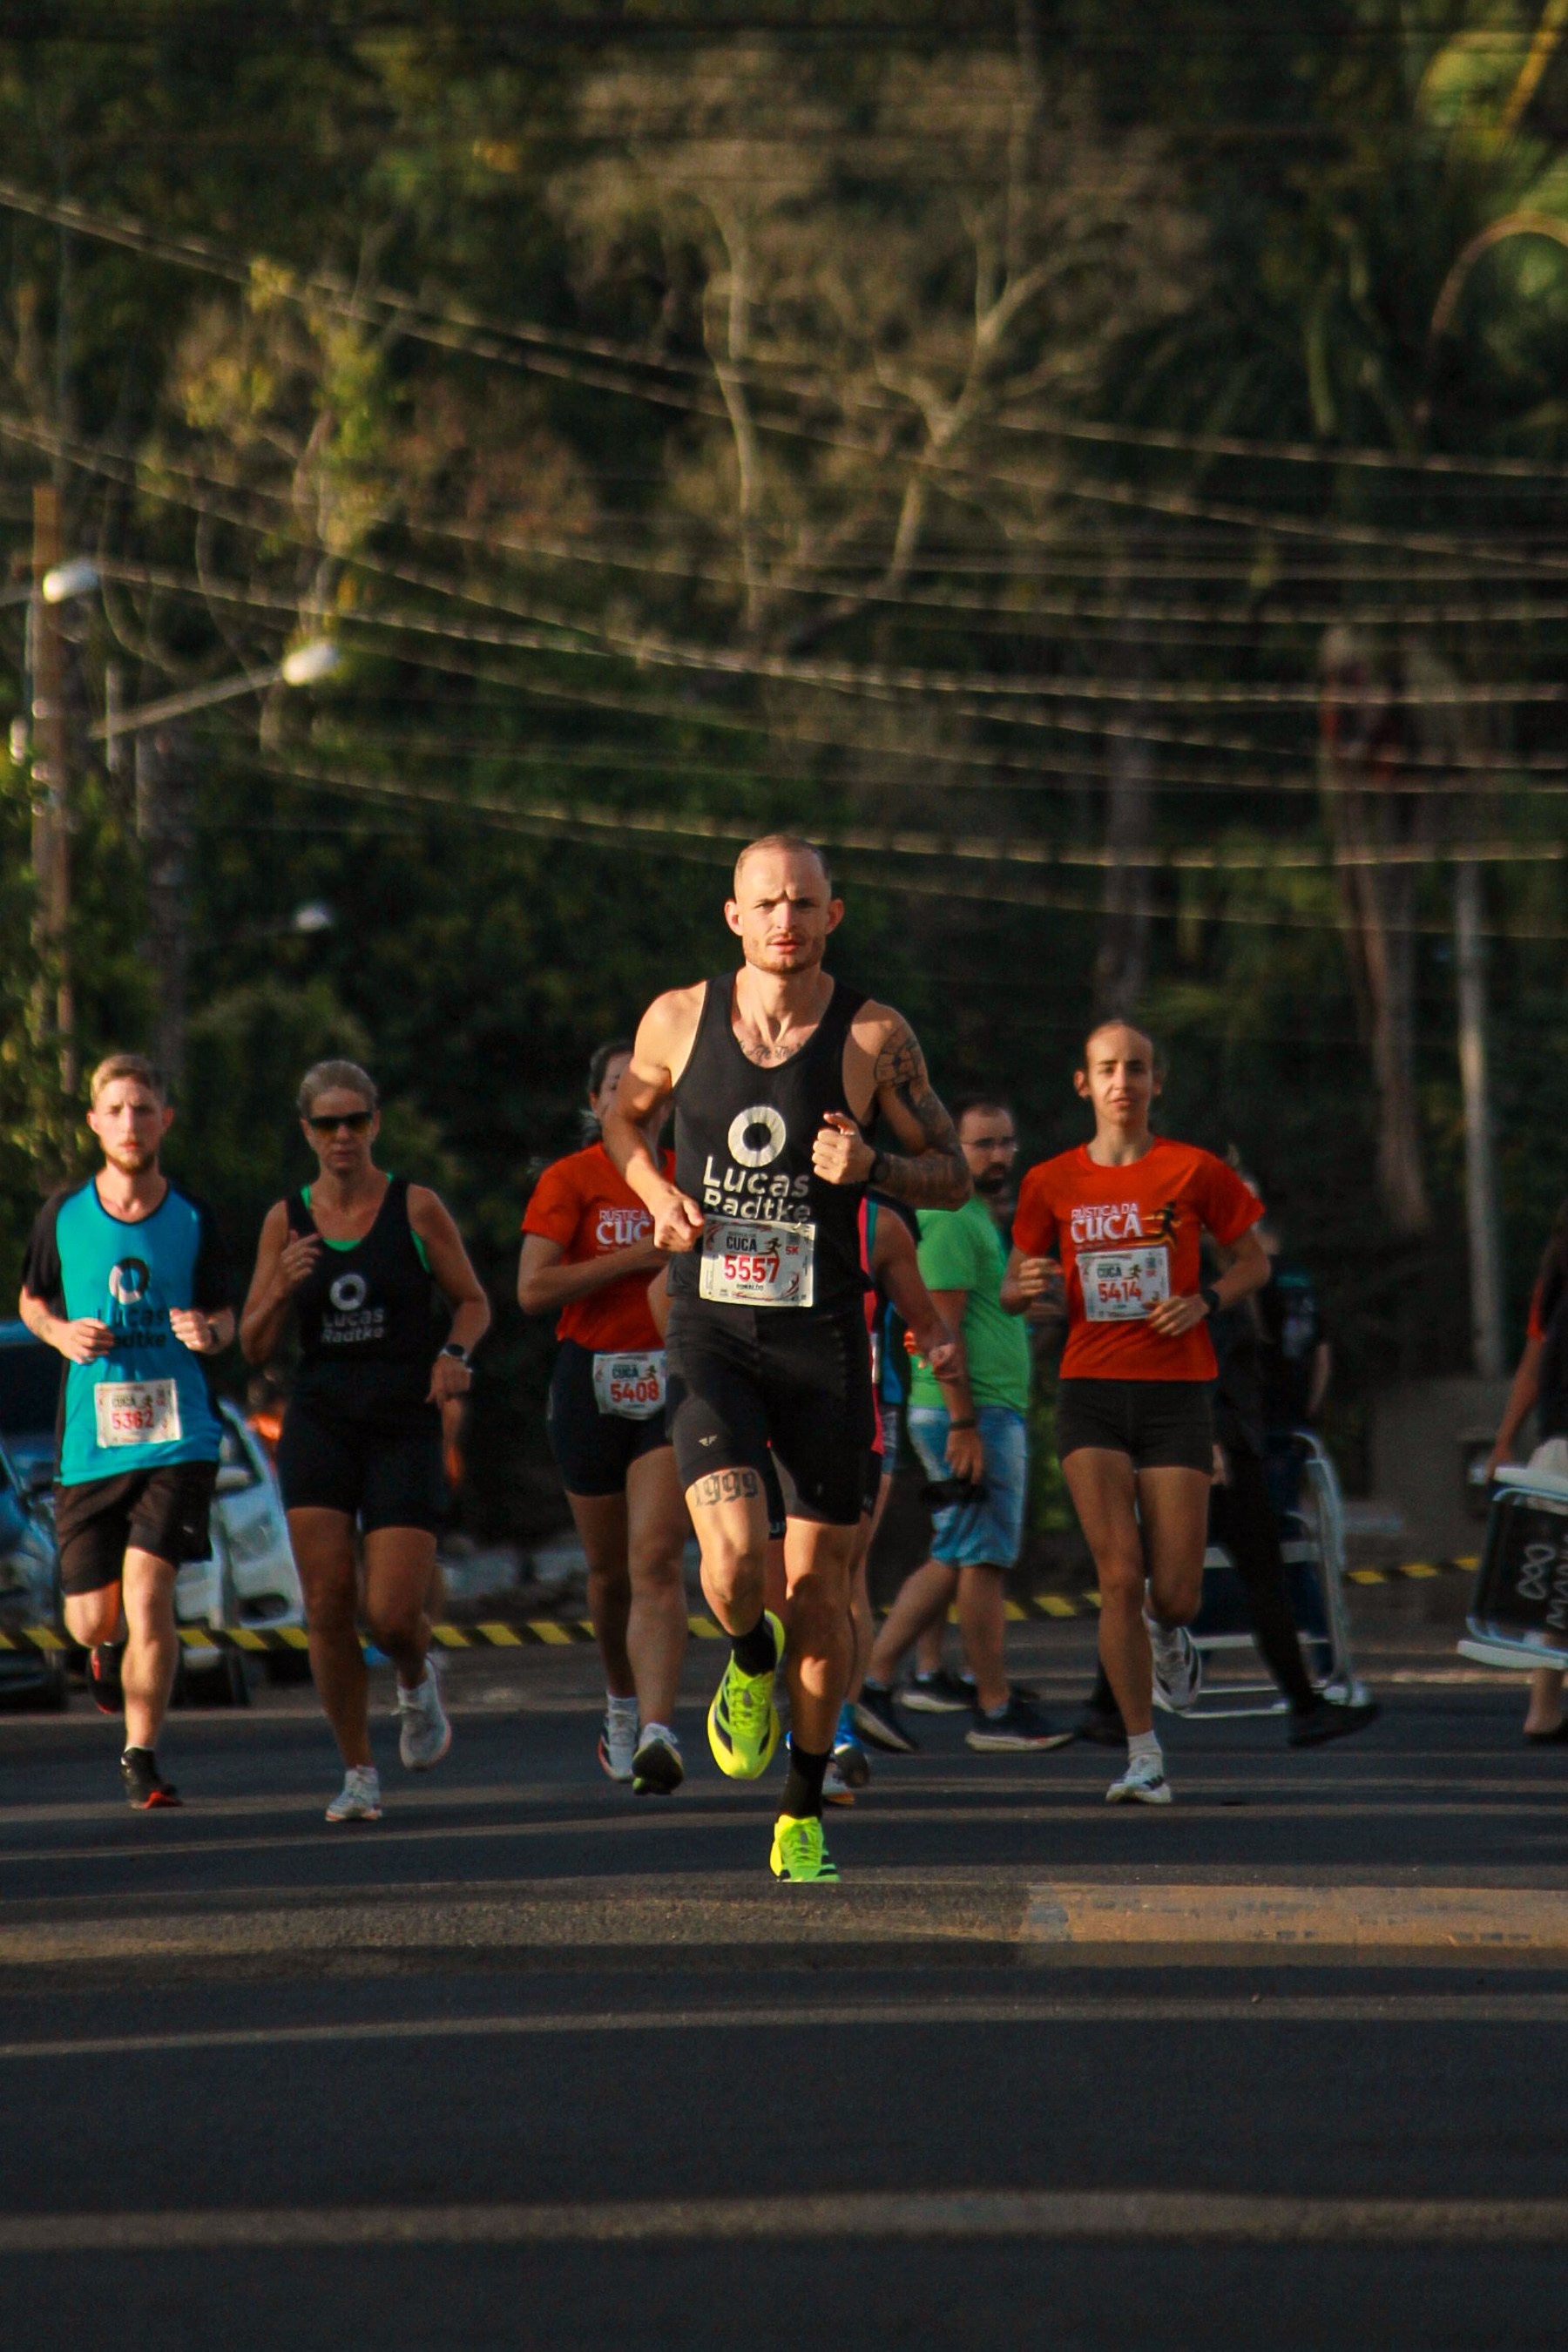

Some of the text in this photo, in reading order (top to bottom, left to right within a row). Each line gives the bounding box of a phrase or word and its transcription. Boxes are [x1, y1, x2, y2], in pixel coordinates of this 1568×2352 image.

[703, 1155, 810, 1198] Lucas
[704, 1187, 811, 1221] Radtke
[1121, 1203, 1139, 1214] DA
[1071, 1213, 1143, 1244] CUCA
[726, 1235, 758, 1252] CUCA
[785, 1245, 800, 1255] 5K
[724, 1254, 781, 1283] 5557
[1098, 1281, 1142, 1303] 5414
[321, 1308, 385, 1328] Lucas
[113, 1330, 166, 1348] adtke
[611, 1380, 659, 1403] 5408
[694, 1470, 759, 1507] 1999
